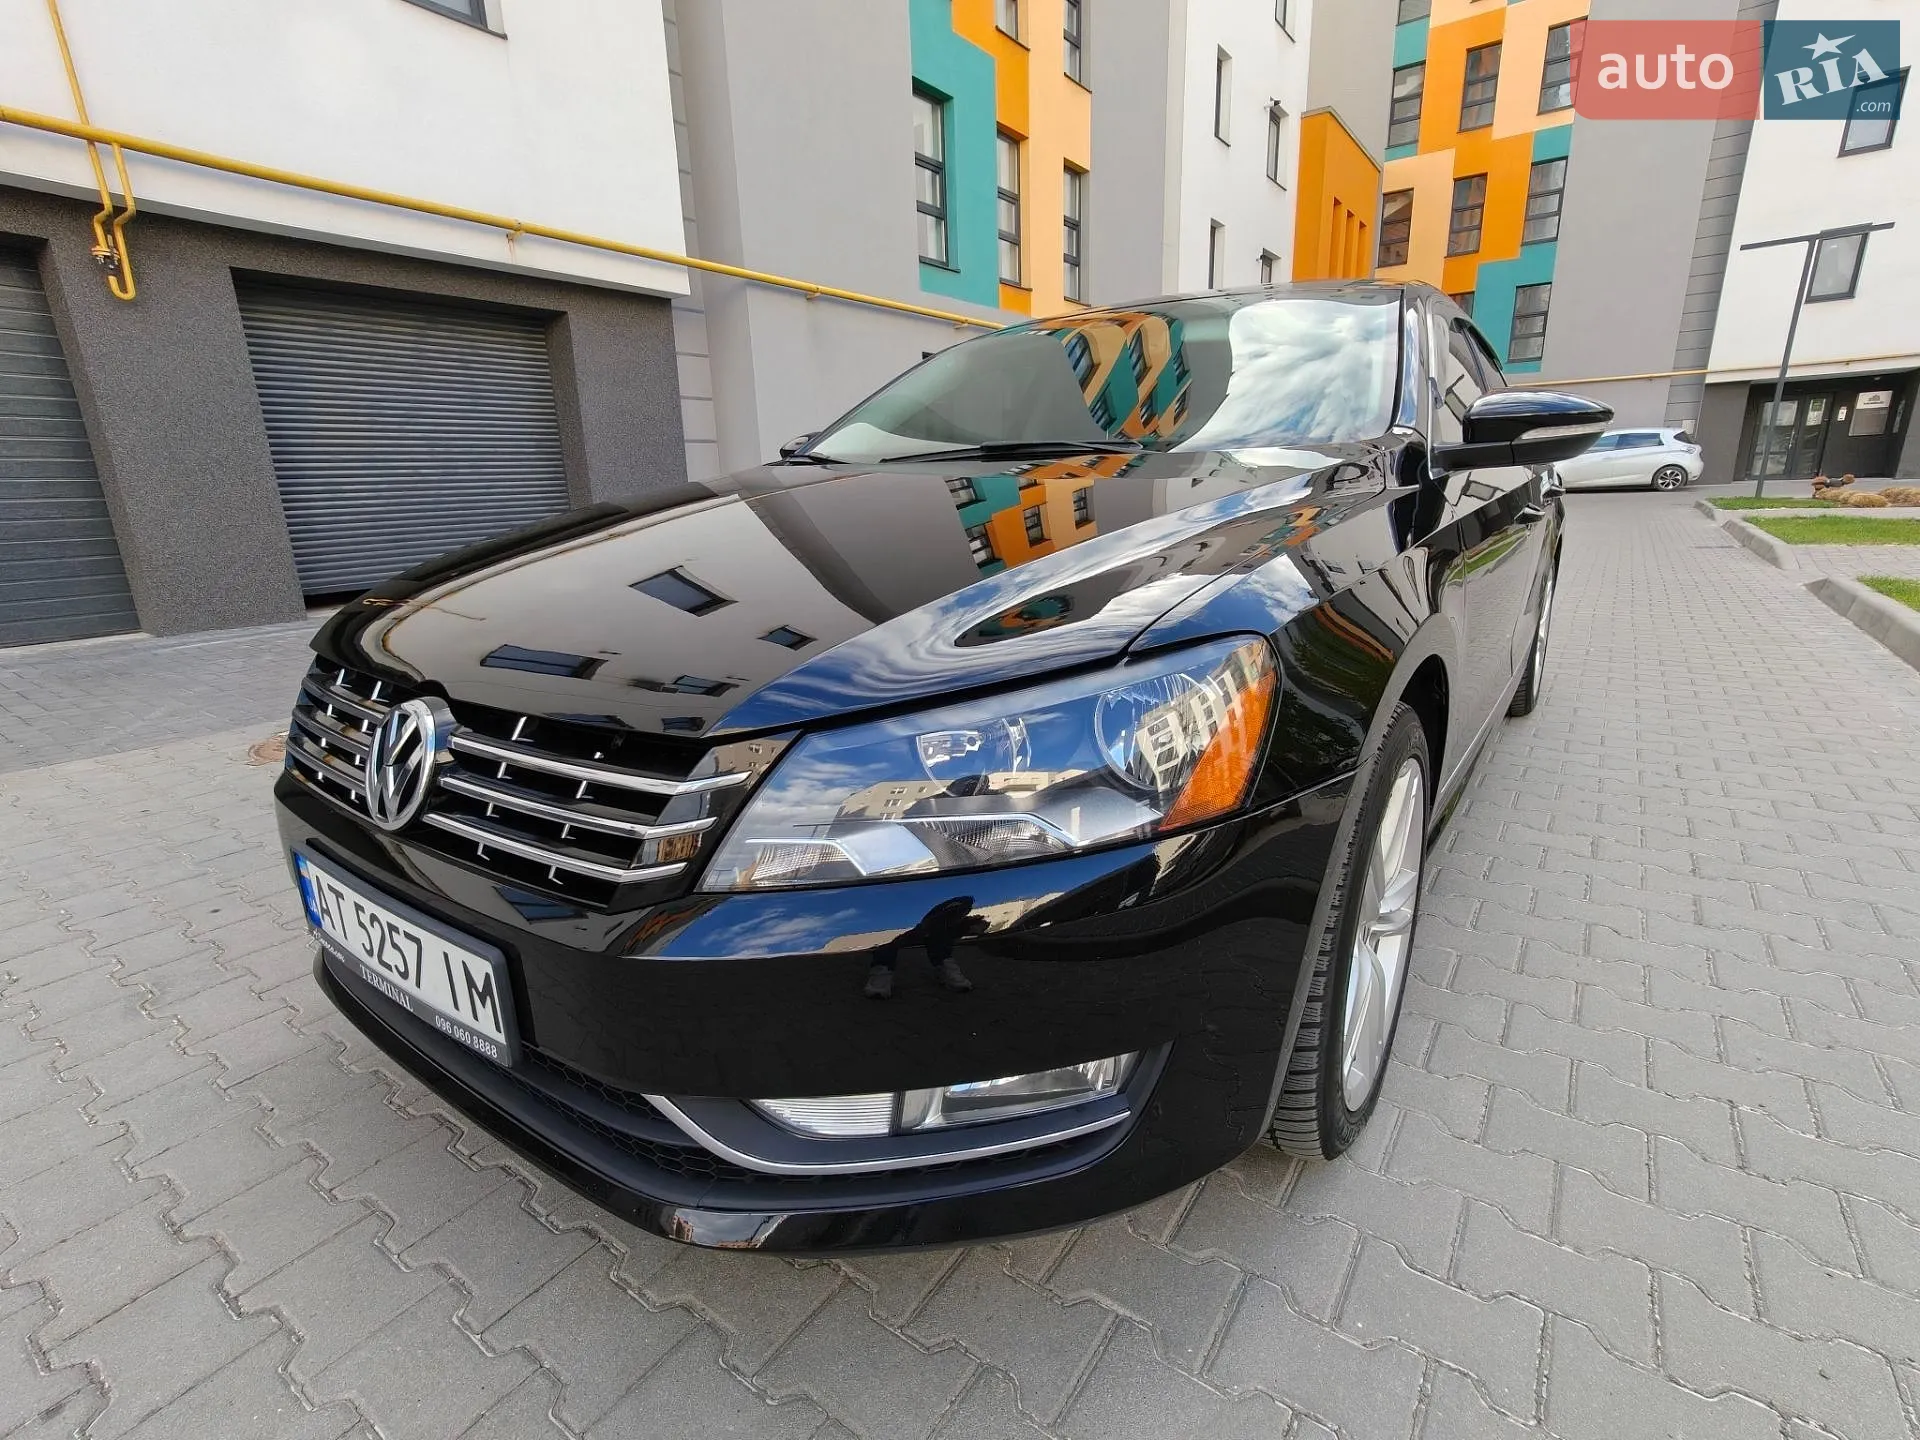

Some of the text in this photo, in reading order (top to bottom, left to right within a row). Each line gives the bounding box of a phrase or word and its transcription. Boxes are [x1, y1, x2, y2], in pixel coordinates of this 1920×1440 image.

[315, 874, 348, 940] AT
[354, 900, 423, 989] 5257
[443, 950, 502, 1034] IM
[359, 963, 414, 1012] TERMINAL
[435, 1015, 498, 1059] 096 060 8888
